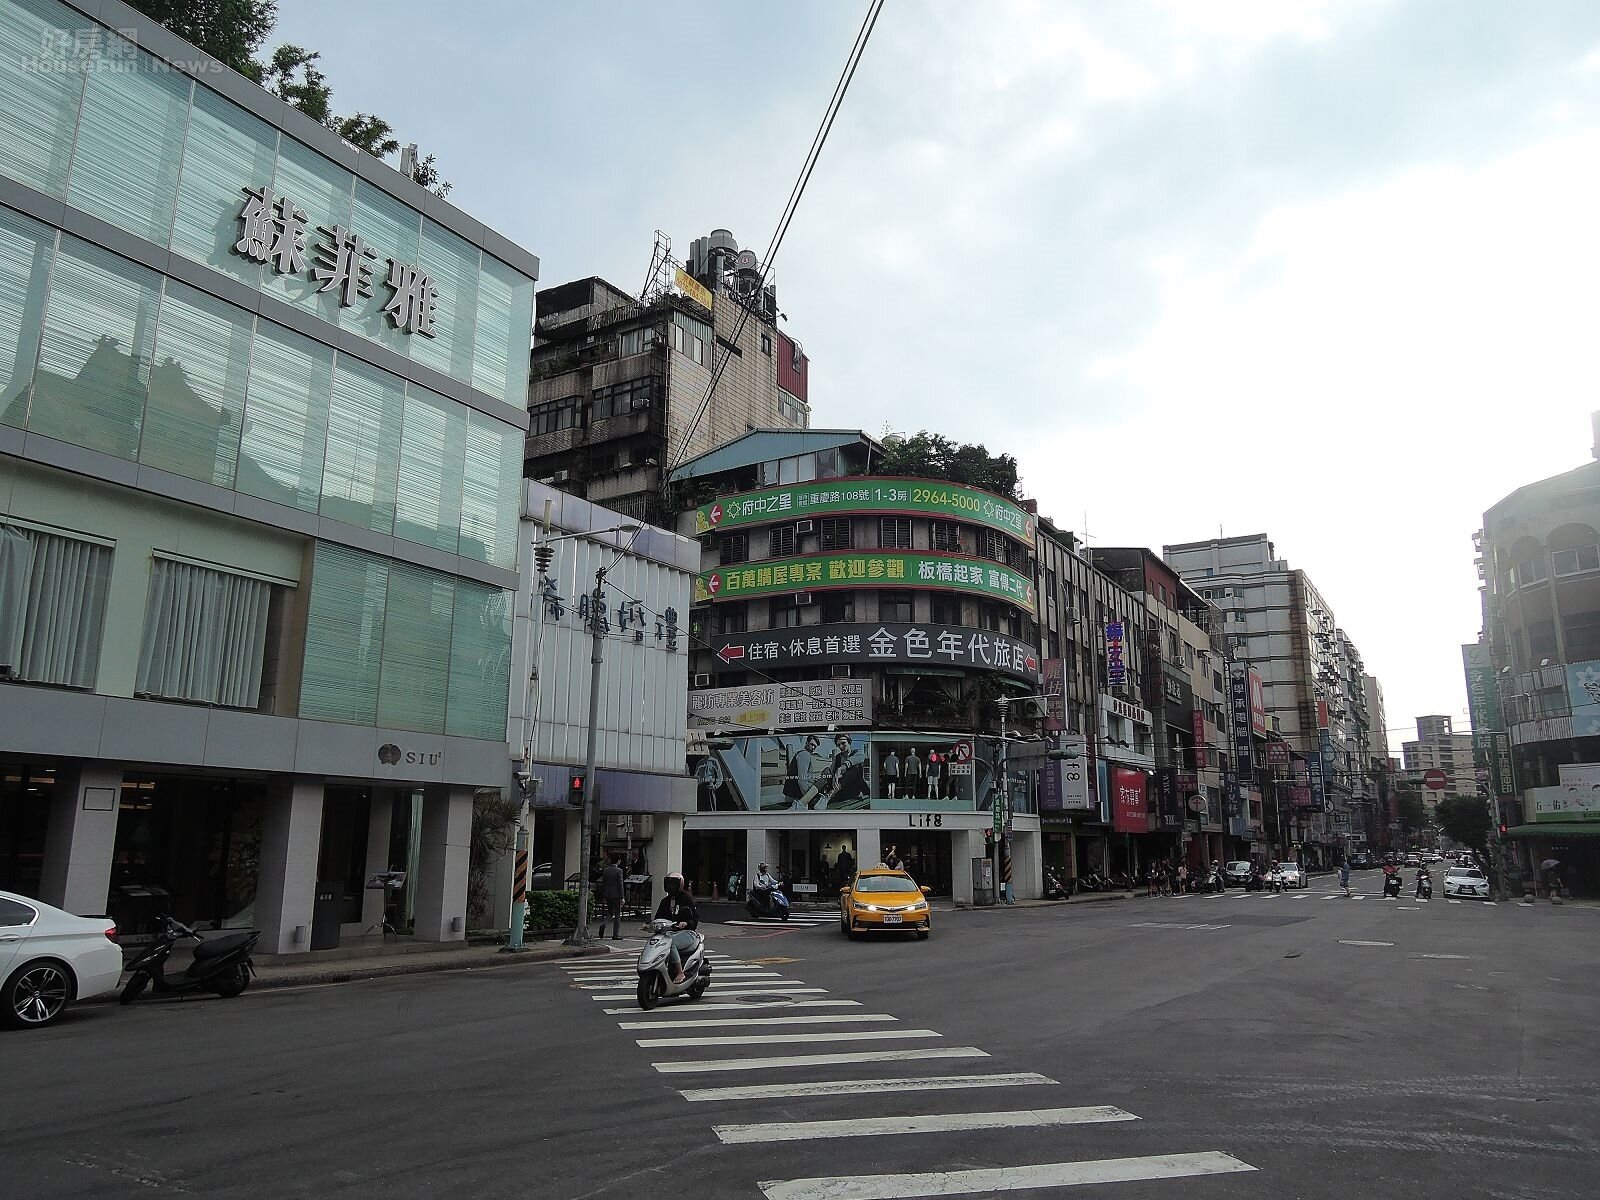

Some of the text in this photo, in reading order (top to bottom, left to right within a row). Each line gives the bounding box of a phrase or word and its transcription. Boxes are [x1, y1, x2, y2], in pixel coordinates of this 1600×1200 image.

[234, 186, 438, 338] 蘇菲雅
[742, 492, 792, 516] 府中之星
[810, 489, 869, 505] 重慶路108號
[875, 488, 907, 502] 1-3房
[913, 488, 980, 512] 2964-5000
[996, 504, 1022, 531] 府中之星
[726, 562, 822, 591] 百萬購屋專案
[829, 558, 904, 580] 歡迎參觀
[919, 560, 983, 585] 板橋起家
[748, 626, 1025, 673] 住宿、休息首選 金色年代旅店
[1066, 743, 1080, 782] Lf8
[908, 813, 942, 828] Lif8
